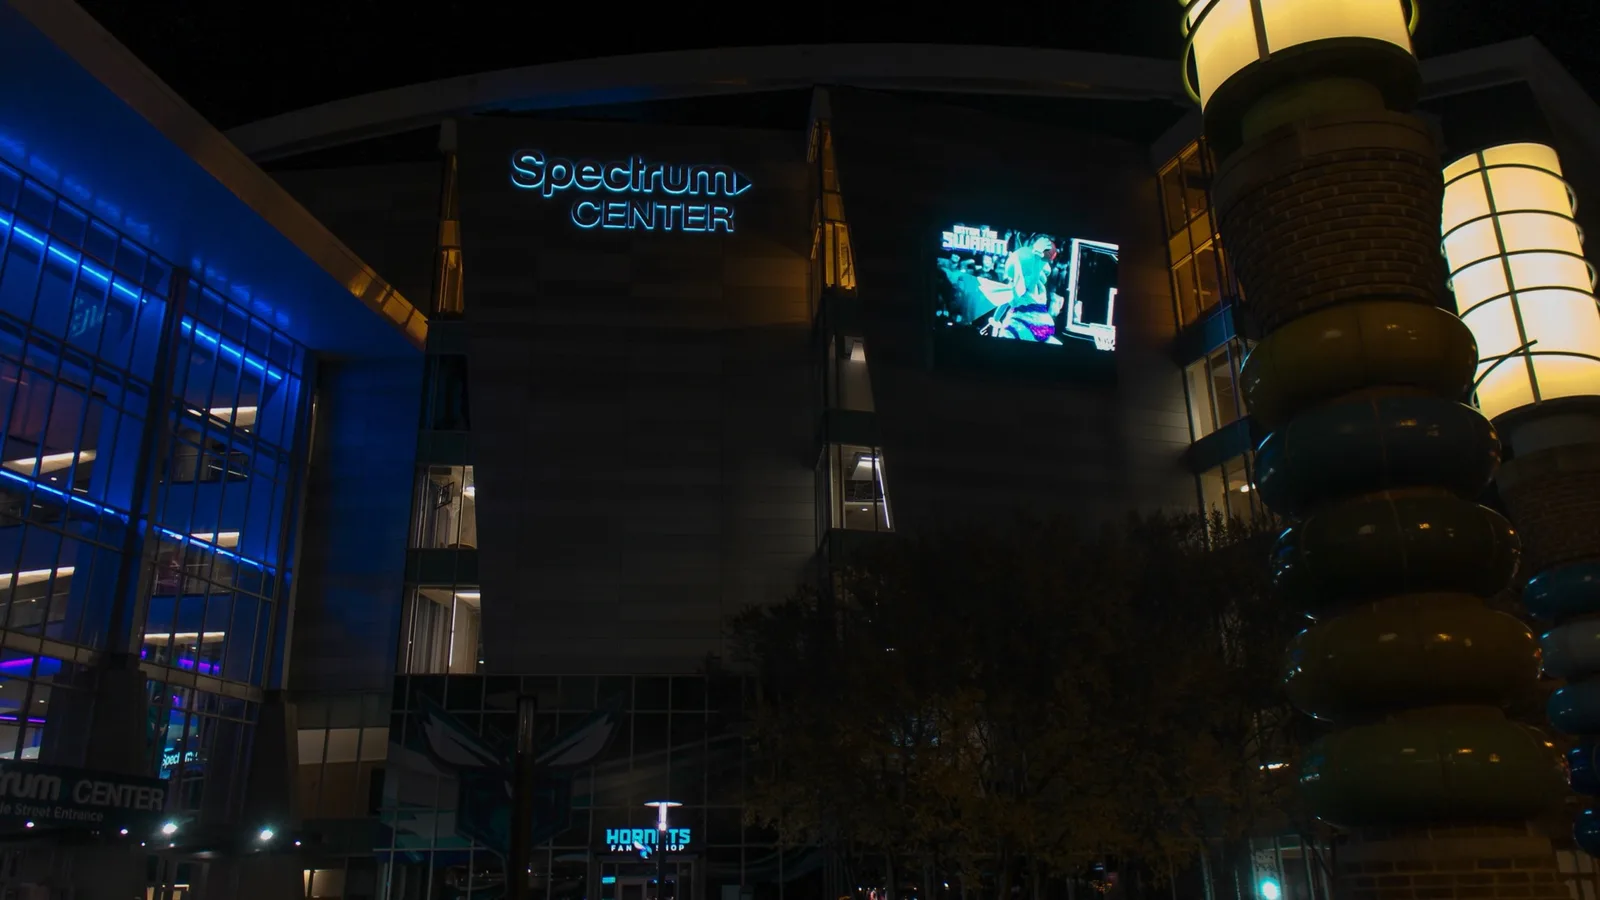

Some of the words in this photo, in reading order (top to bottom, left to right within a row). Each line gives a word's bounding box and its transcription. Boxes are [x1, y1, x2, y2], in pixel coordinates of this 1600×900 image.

[510, 150, 737, 198] Spectrum
[571, 200, 735, 232] CENTER
[942, 231, 1008, 256] SWARM
[0, 764, 62, 801] rum
[72, 779, 165, 812] CENTER
[15, 803, 51, 819] Street
[54, 806, 104, 822] Entrance
[606, 828, 691, 844] HORNTS
[610, 844, 633, 852] FAN
